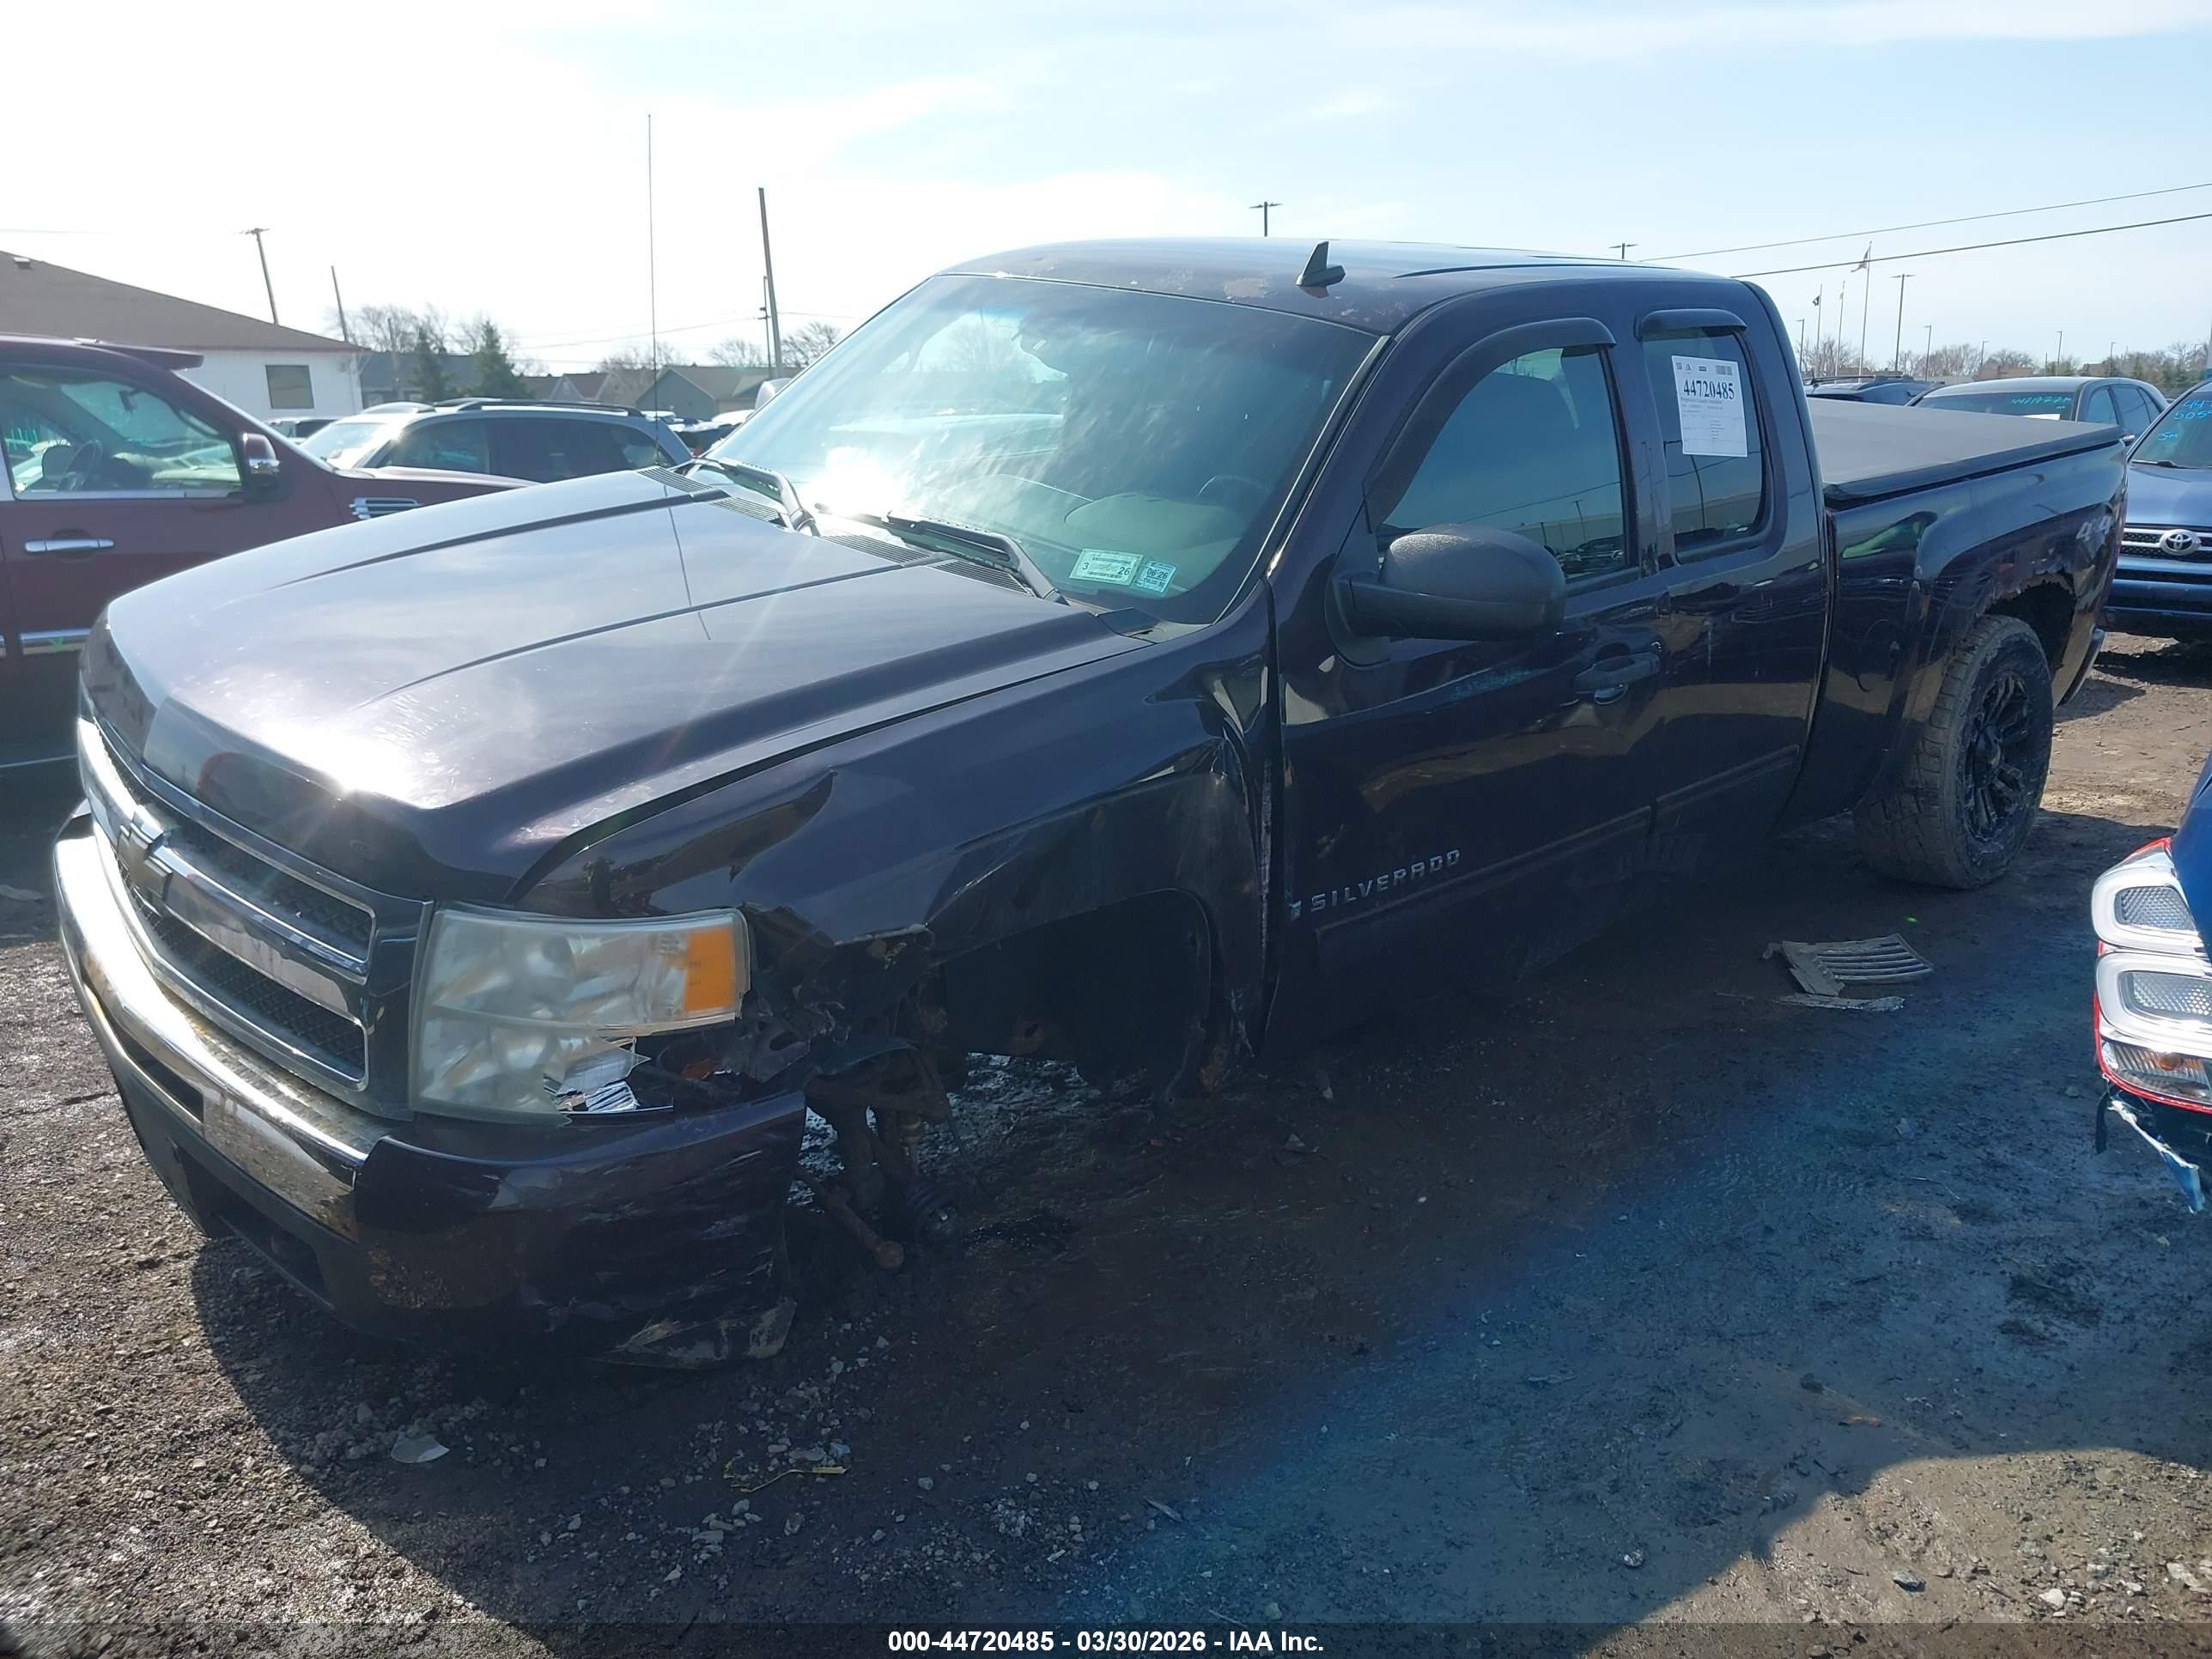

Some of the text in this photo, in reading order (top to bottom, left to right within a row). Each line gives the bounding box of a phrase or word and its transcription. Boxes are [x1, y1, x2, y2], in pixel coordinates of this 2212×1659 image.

[1683, 379, 1735, 400] 44720485
[1118, 567, 1131, 576] 26
[1310, 849, 1460, 912] SILVERADO
